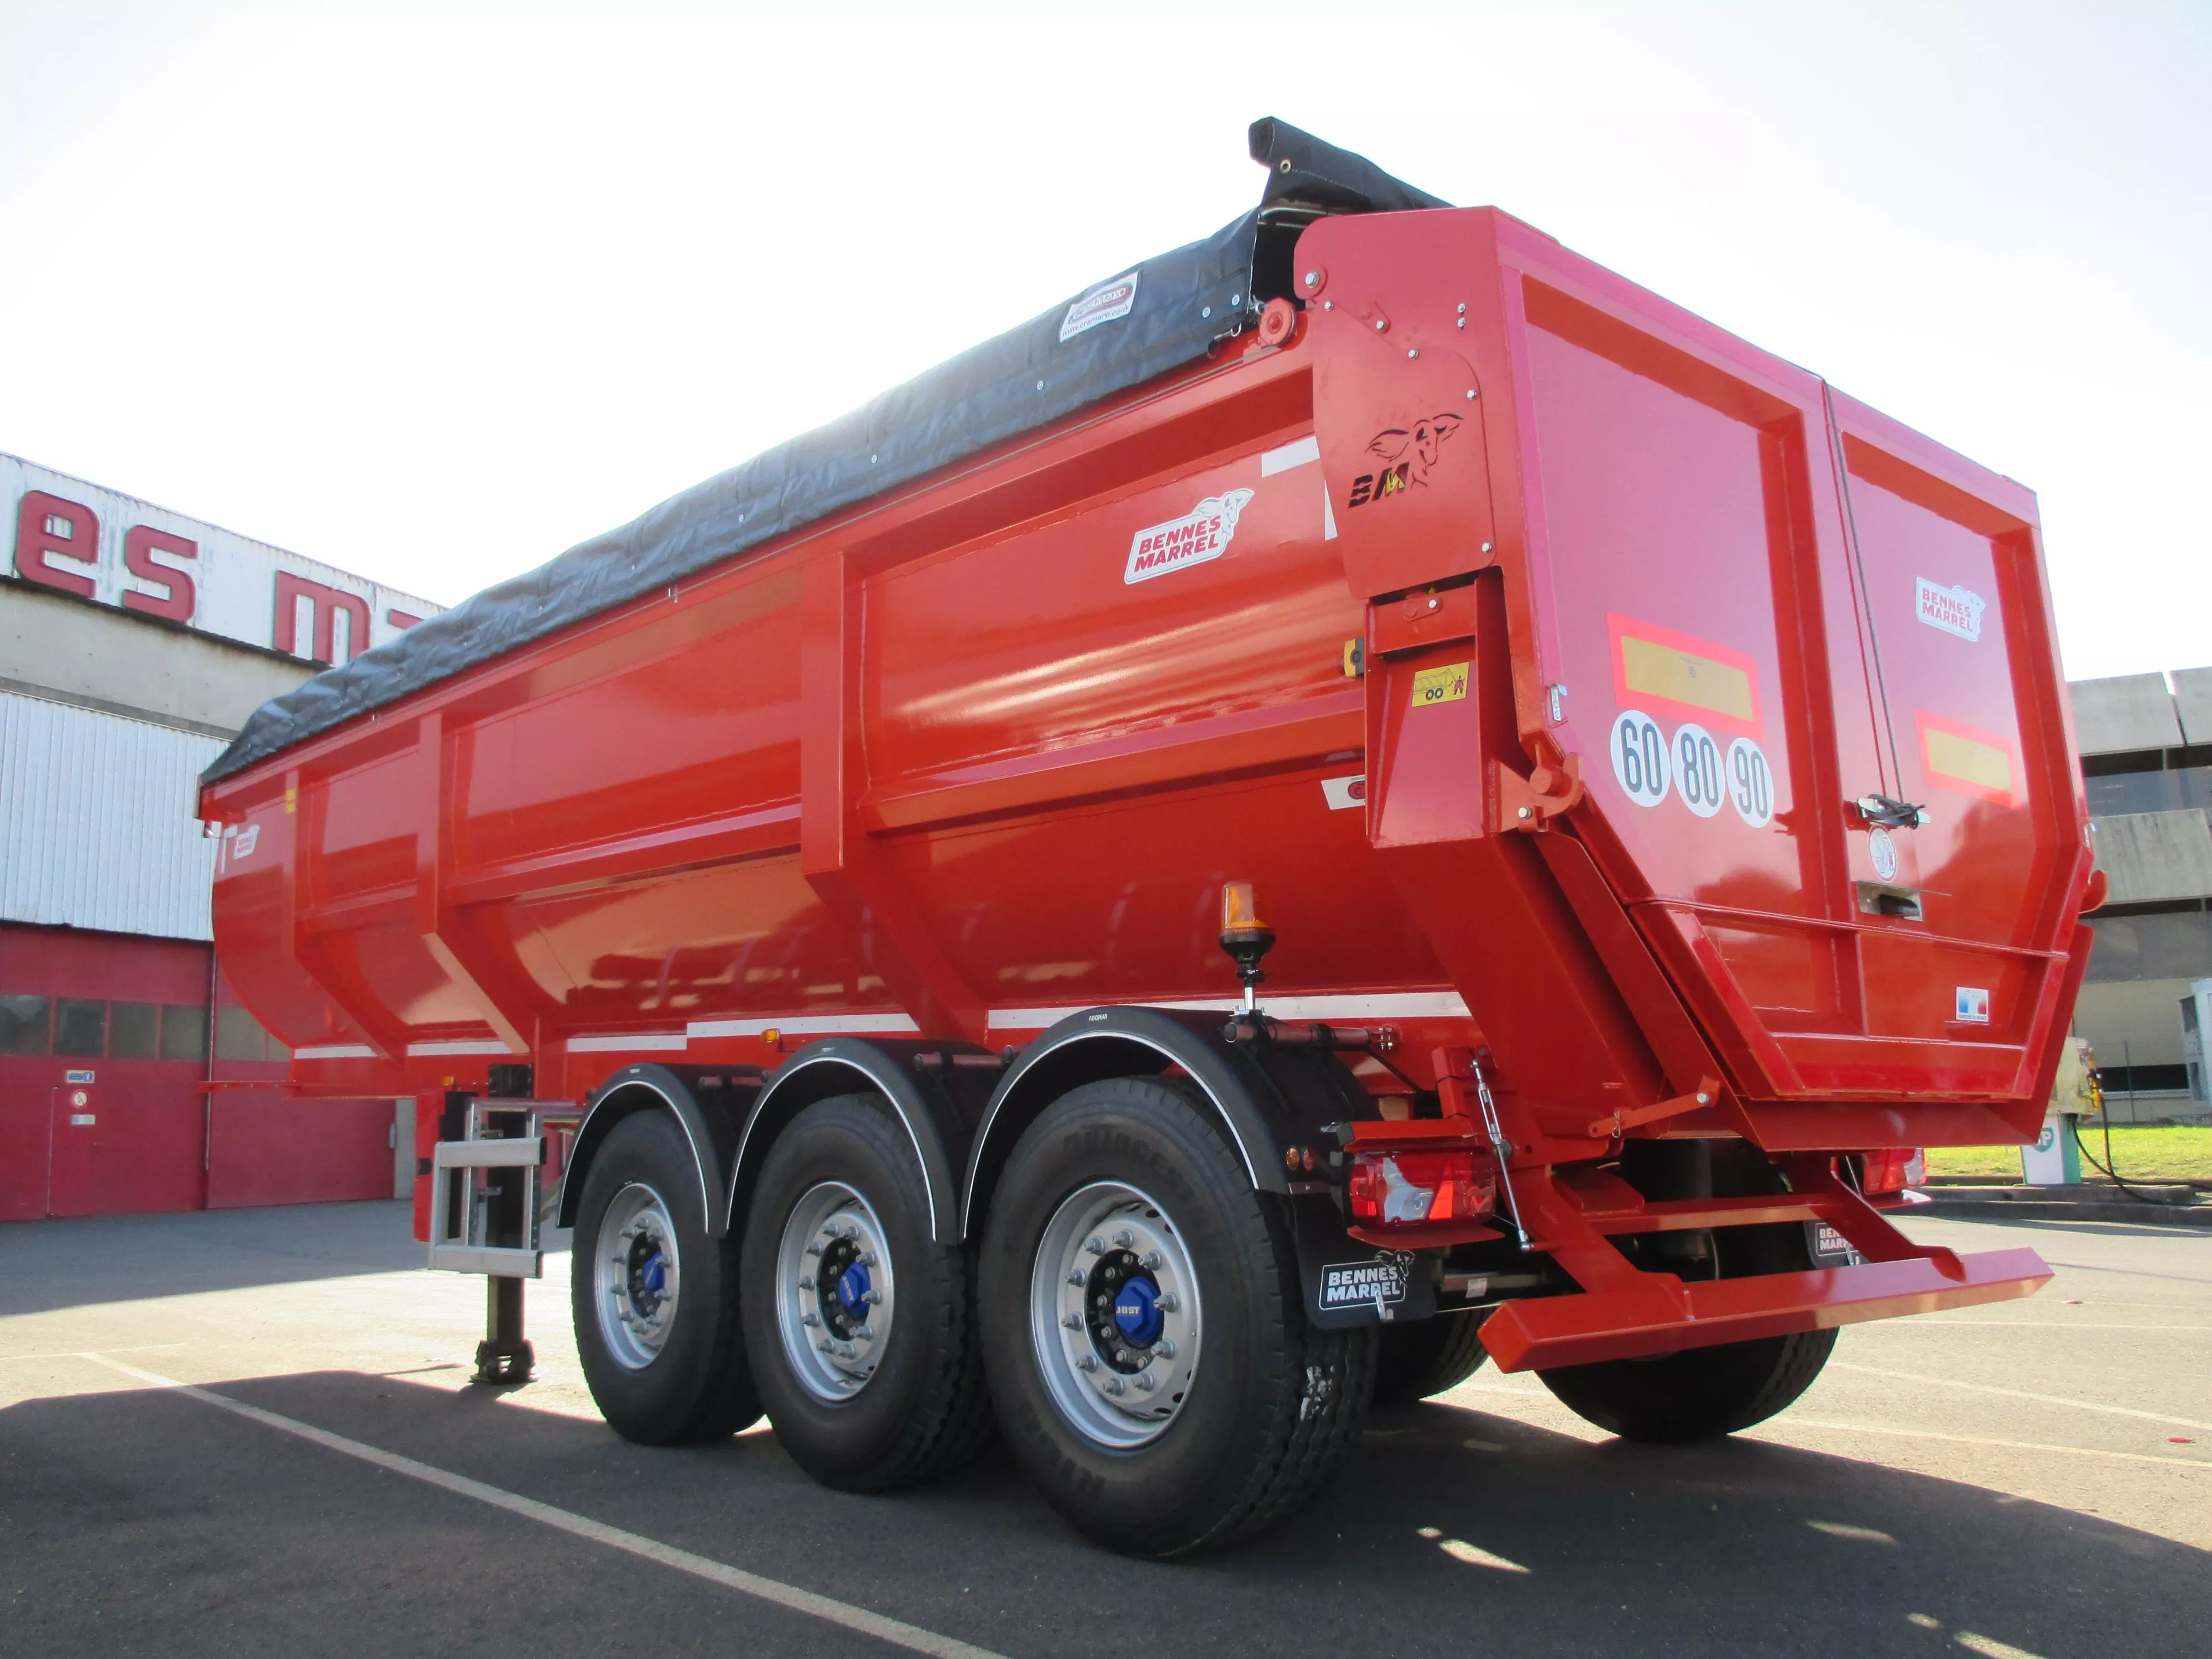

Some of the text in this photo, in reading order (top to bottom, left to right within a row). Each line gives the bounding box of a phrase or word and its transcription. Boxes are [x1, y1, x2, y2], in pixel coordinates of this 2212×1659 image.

[1139, 515, 1221, 555] BENNES
[1134, 534, 1218, 572] MARREL
[274, 570, 425, 666] m
[1922, 588, 1971, 618] BENNES
[1922, 601, 1973, 633] MARREL
[1620, 719, 1767, 819] 60 80 90
[1327, 1281, 1400, 1302] MARREL
[1328, 1266, 1398, 1286] BENNES
[1116, 1306, 1140, 1314] JOST
